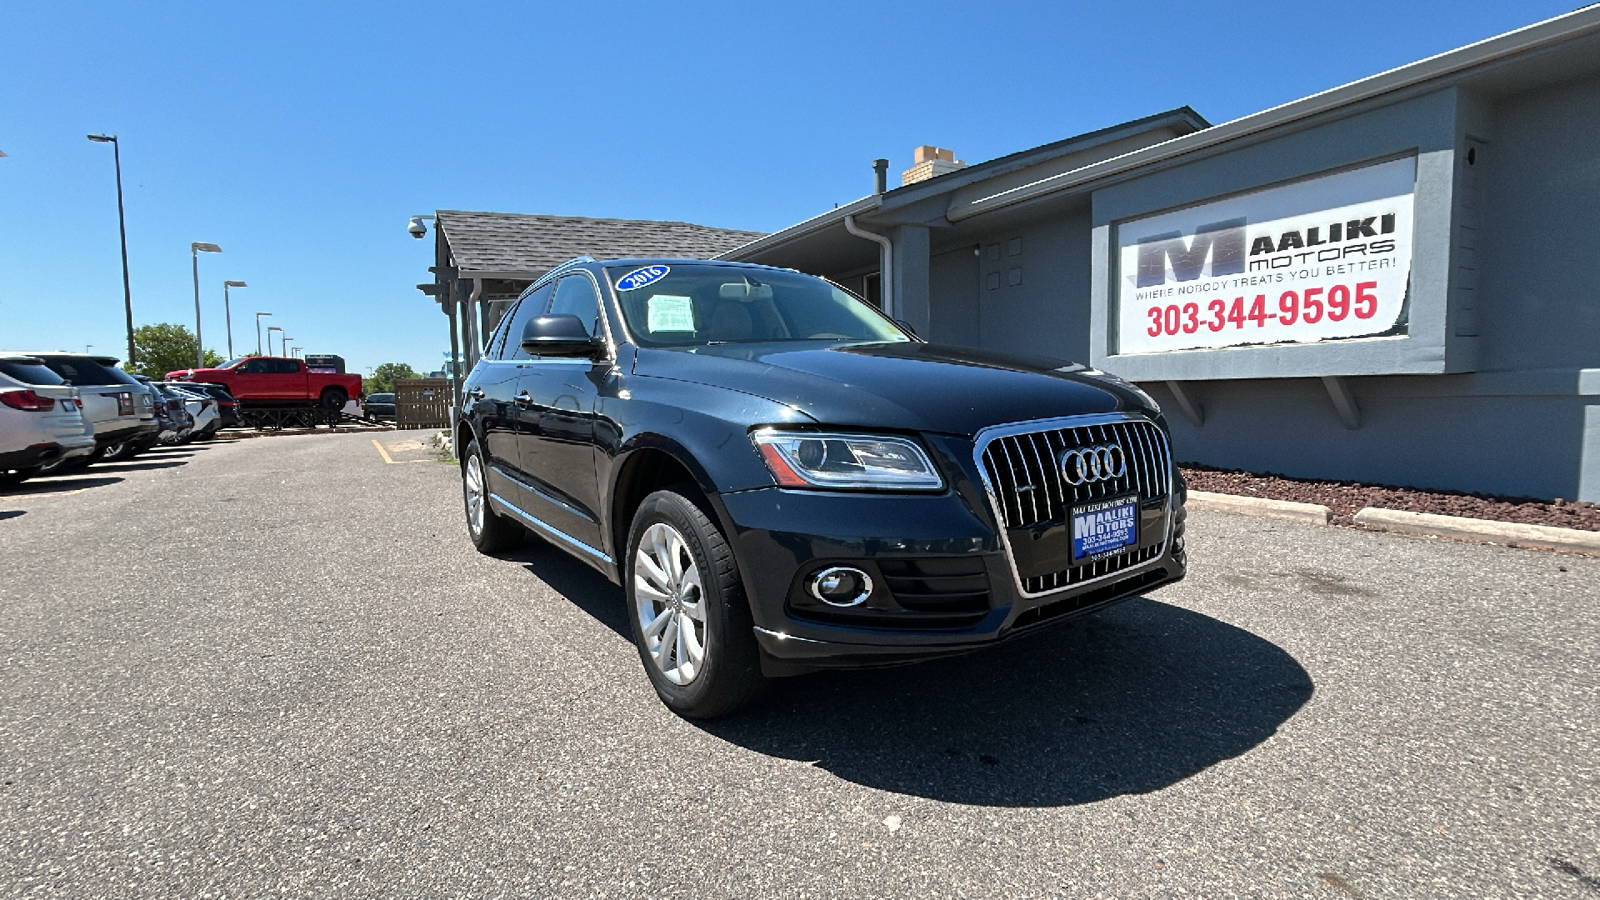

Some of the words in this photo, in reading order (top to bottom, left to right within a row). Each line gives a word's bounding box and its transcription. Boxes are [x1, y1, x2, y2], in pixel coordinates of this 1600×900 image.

[1249, 239, 1396, 272] MOTORS
[625, 266, 662, 287] 2016
[1135, 288, 1174, 301] WHERE
[1178, 280, 1228, 295] NOBODY
[1233, 273, 1283, 288] TREATS
[1290, 267, 1319, 280] YOU
[1326, 257, 1396, 276] BETTER!
[1147, 280, 1378, 337] 303-344-9595
[1083, 528, 1128, 545] 303-344-9595
